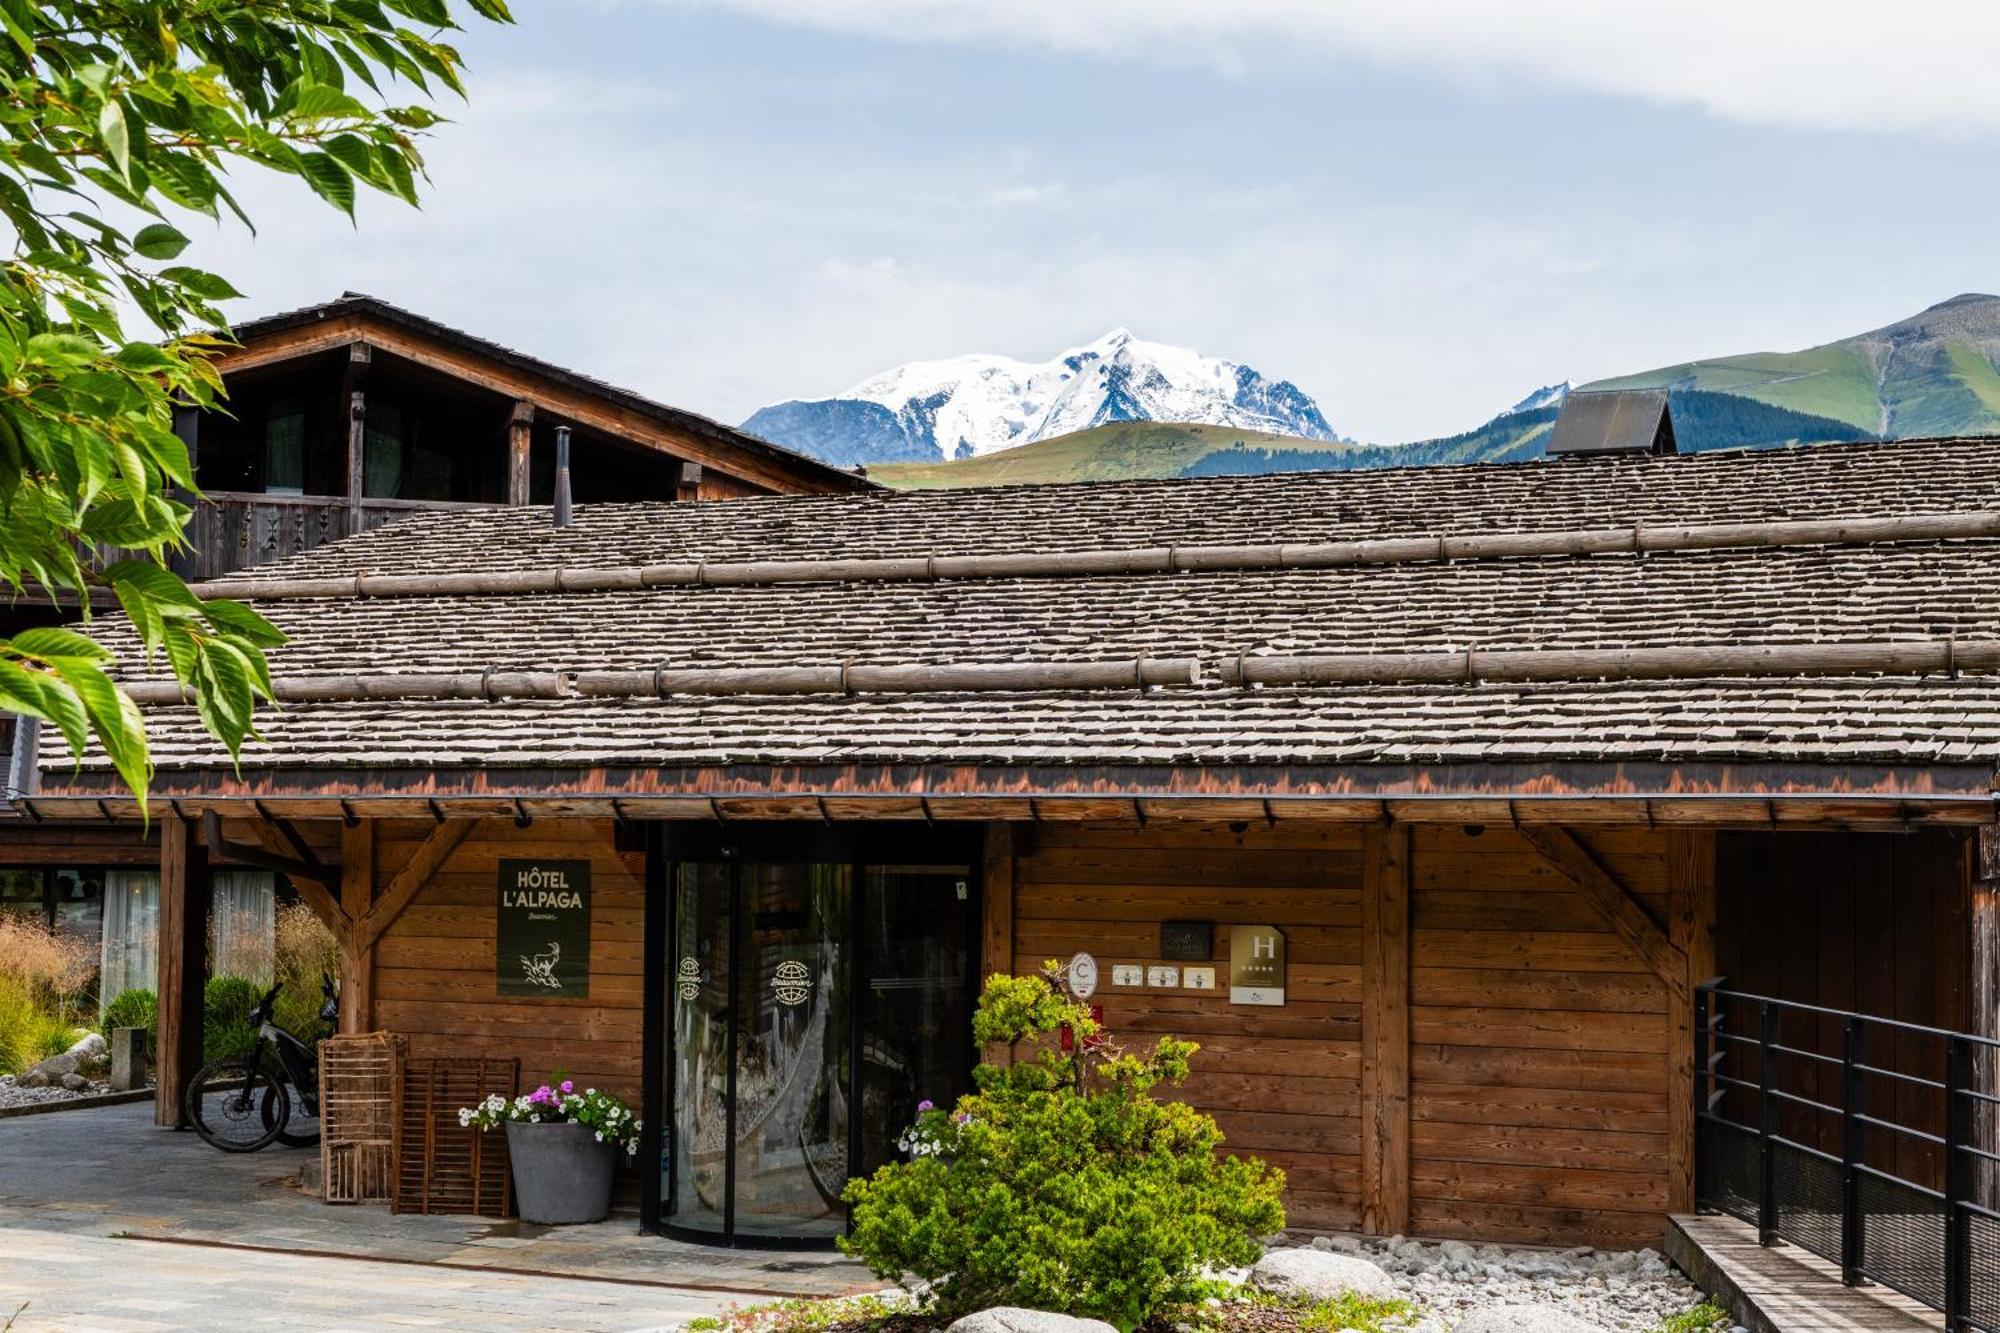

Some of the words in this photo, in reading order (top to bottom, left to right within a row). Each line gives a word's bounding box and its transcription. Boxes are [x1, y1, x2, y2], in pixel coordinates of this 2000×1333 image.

[518, 867, 569, 888] HÔTEL
[503, 891, 582, 909] L'ALPAGA
[1255, 936, 1275, 958] H
[1076, 963, 1089, 978] C
